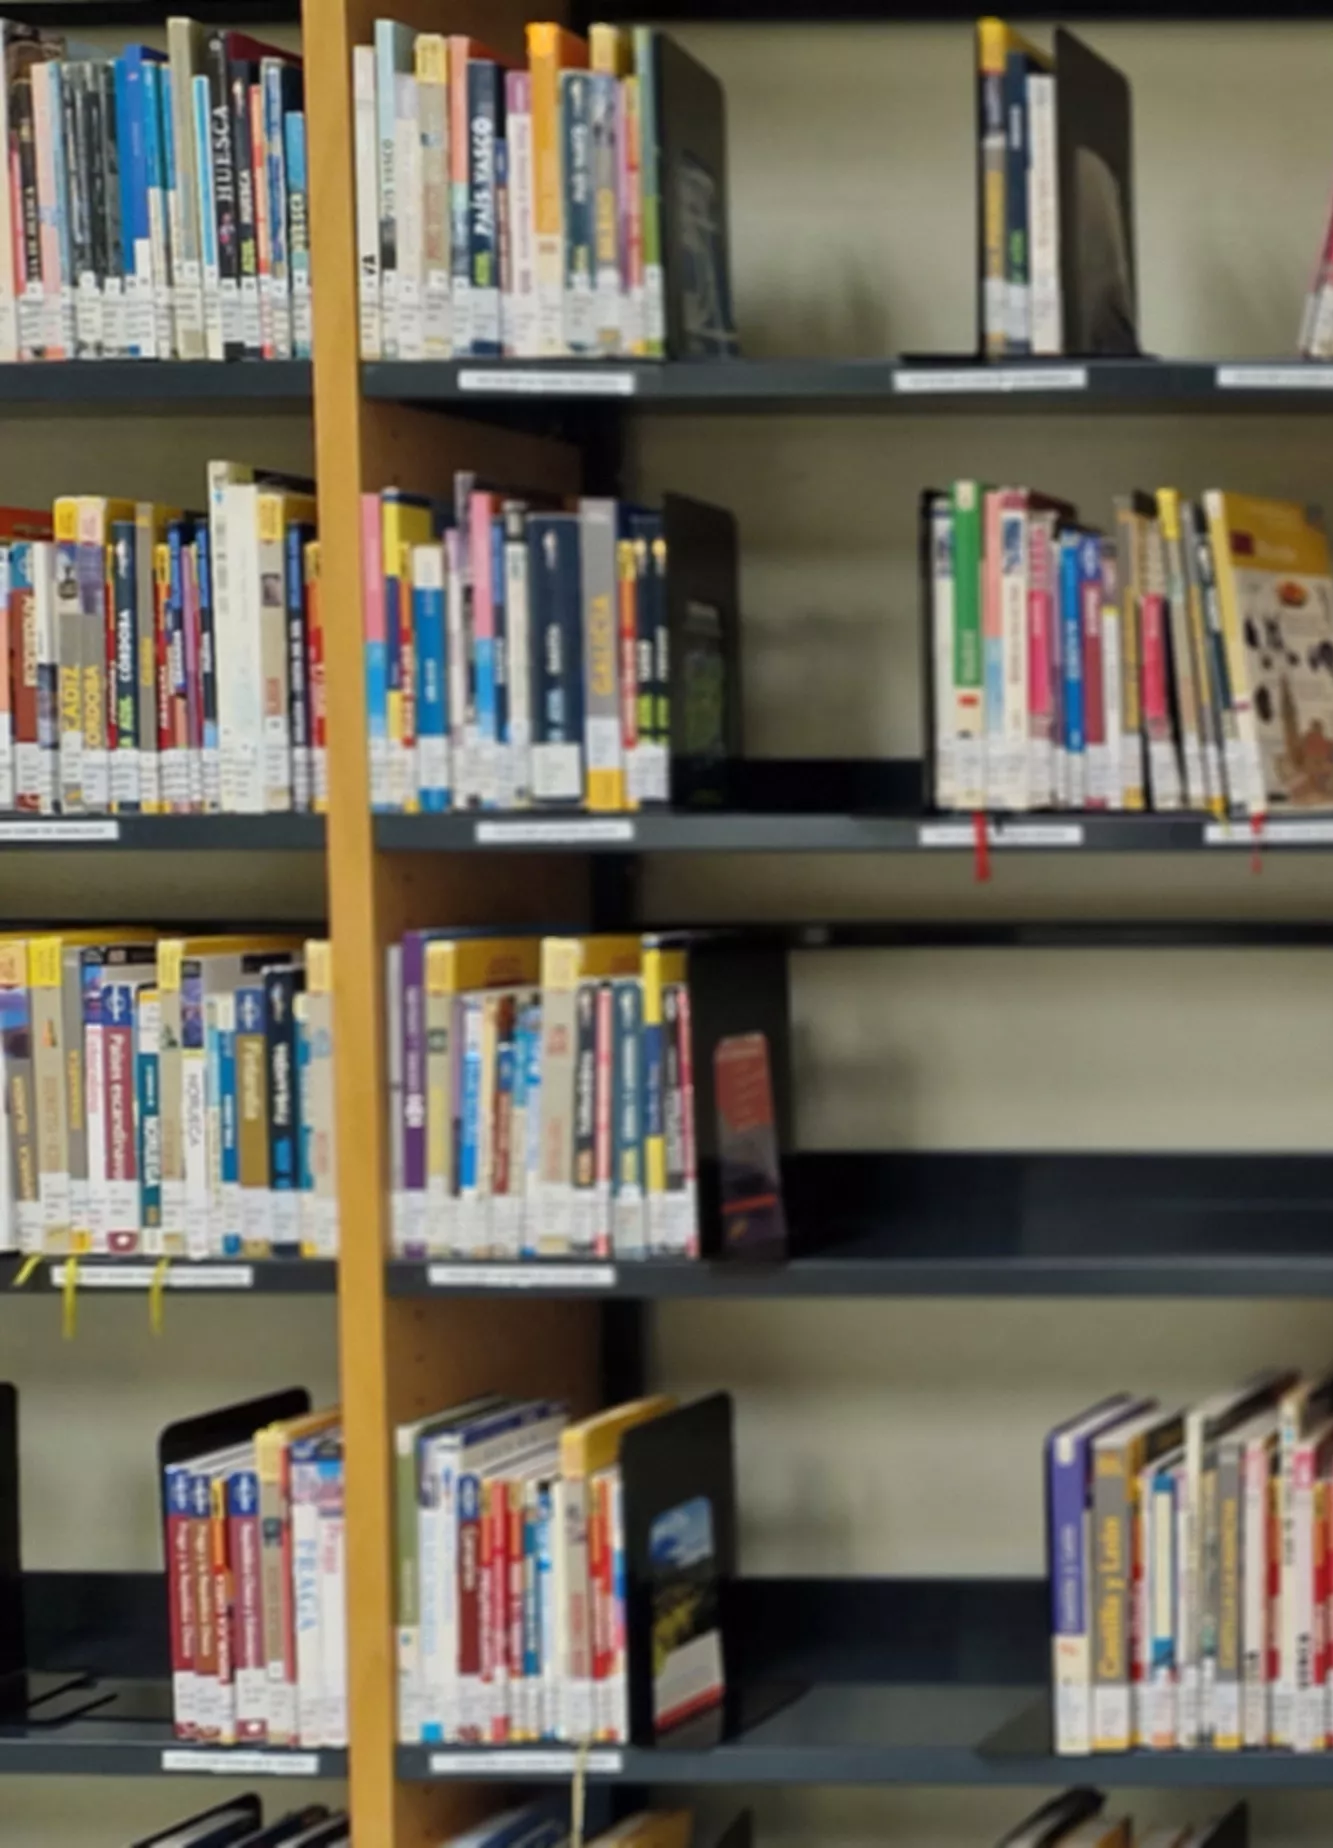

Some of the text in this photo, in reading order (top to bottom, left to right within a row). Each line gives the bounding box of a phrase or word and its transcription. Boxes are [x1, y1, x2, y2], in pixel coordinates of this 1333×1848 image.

[213, 104, 237, 202] HUESCA
[472, 117, 493, 183] VASCO
[115, 609, 132, 683] CÓRDOBA
[84, 666, 102, 749] ORDOBA
[1096, 1515, 1124, 1678] Castilla y León
